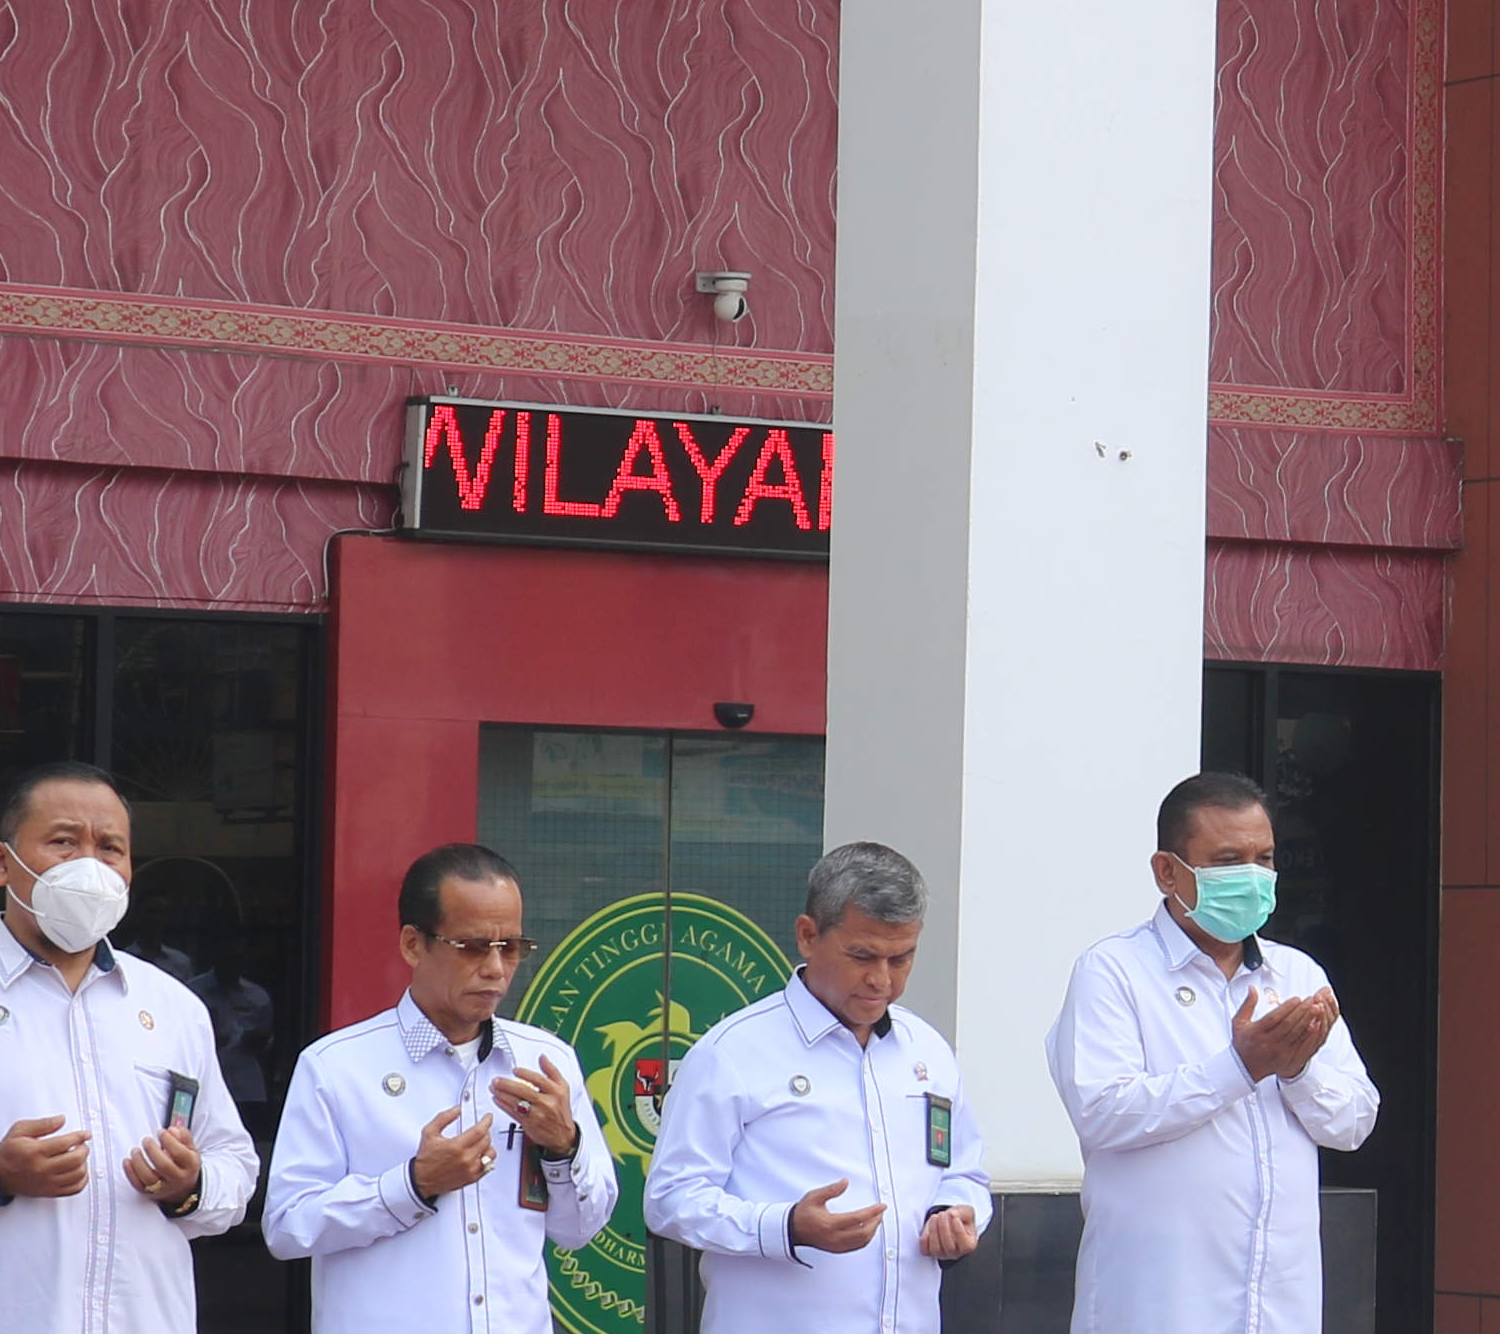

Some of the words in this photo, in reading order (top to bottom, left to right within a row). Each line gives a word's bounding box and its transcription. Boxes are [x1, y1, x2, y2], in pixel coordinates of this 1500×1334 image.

[540, 979, 580, 1036] LAN
[680, 924, 768, 994] AGAMA
[594, 1231, 646, 1266] DHARM
